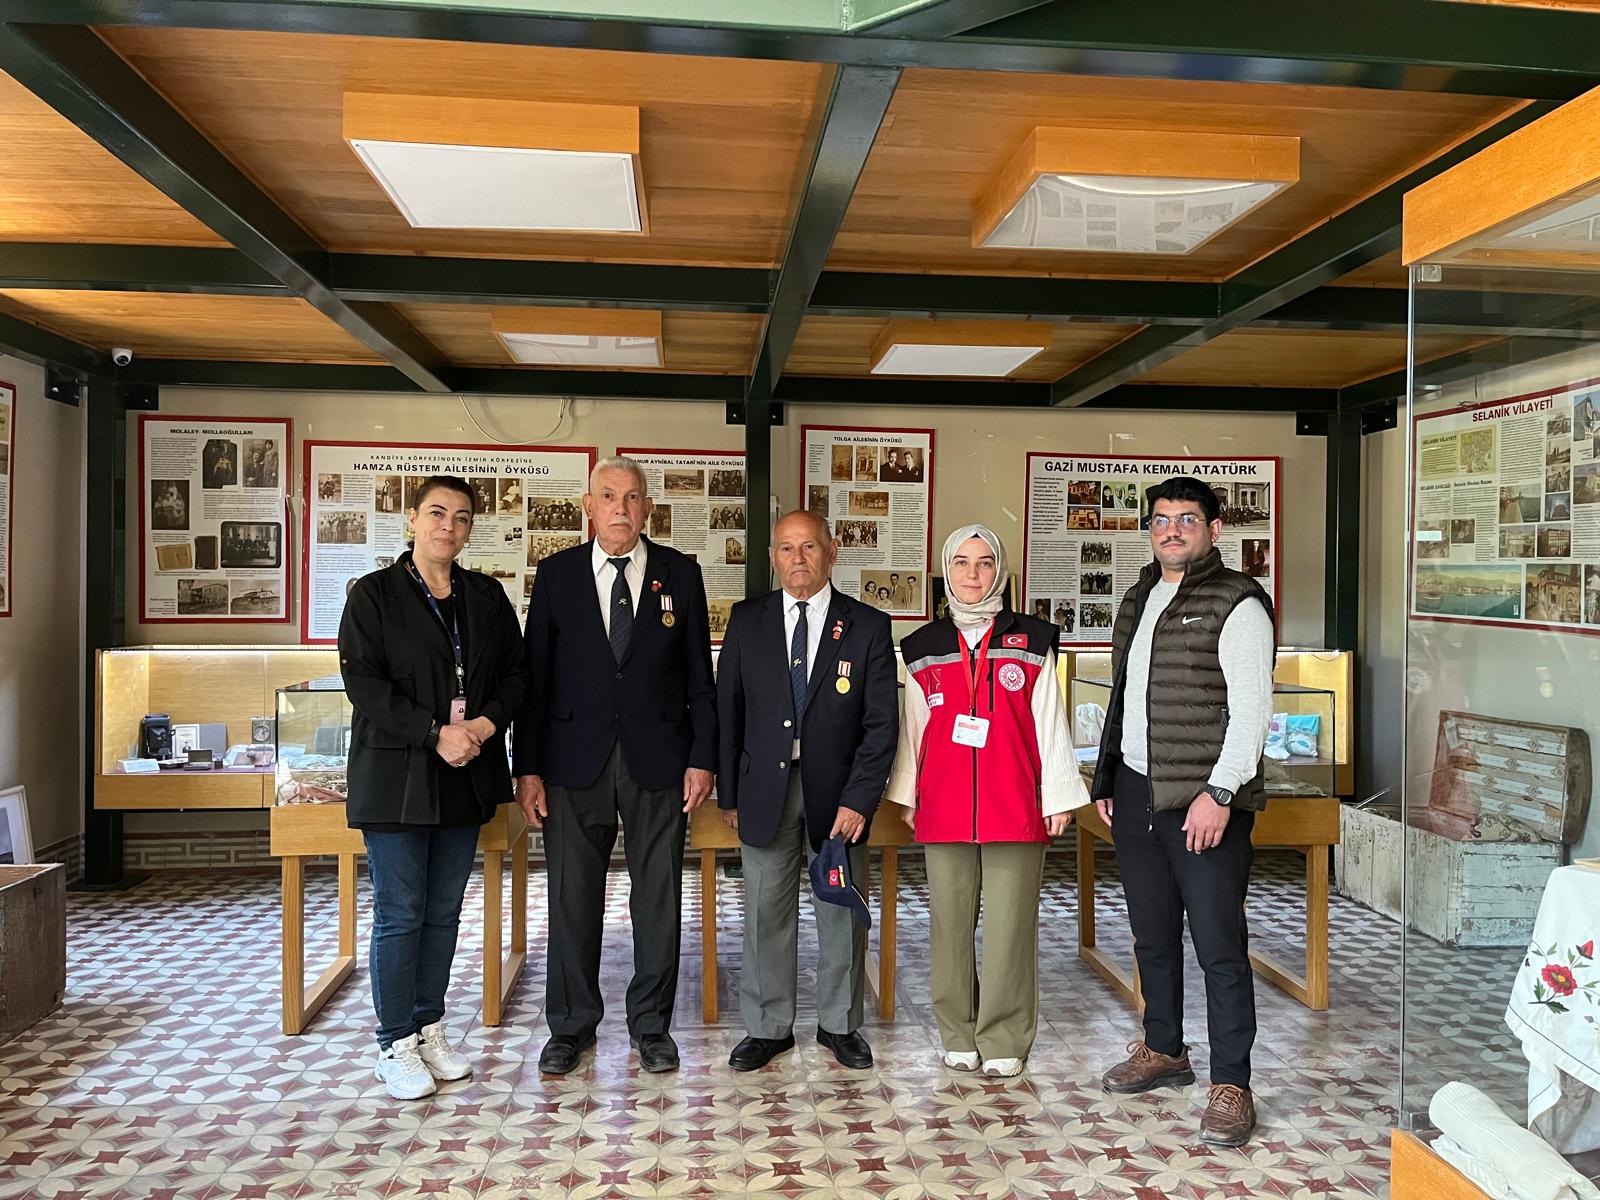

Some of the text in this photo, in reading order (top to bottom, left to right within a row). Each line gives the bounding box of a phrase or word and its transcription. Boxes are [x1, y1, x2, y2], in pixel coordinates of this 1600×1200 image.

[1472, 396, 1553, 422] SELANİK VİLAYETİ
[354, 462, 549, 475] HAMZA RÜSTEM AİLESİNİN ÖYKÜSÜ
[1045, 460, 1256, 475] GAZİ MUSTAFA KEMAL ATATÜRK
